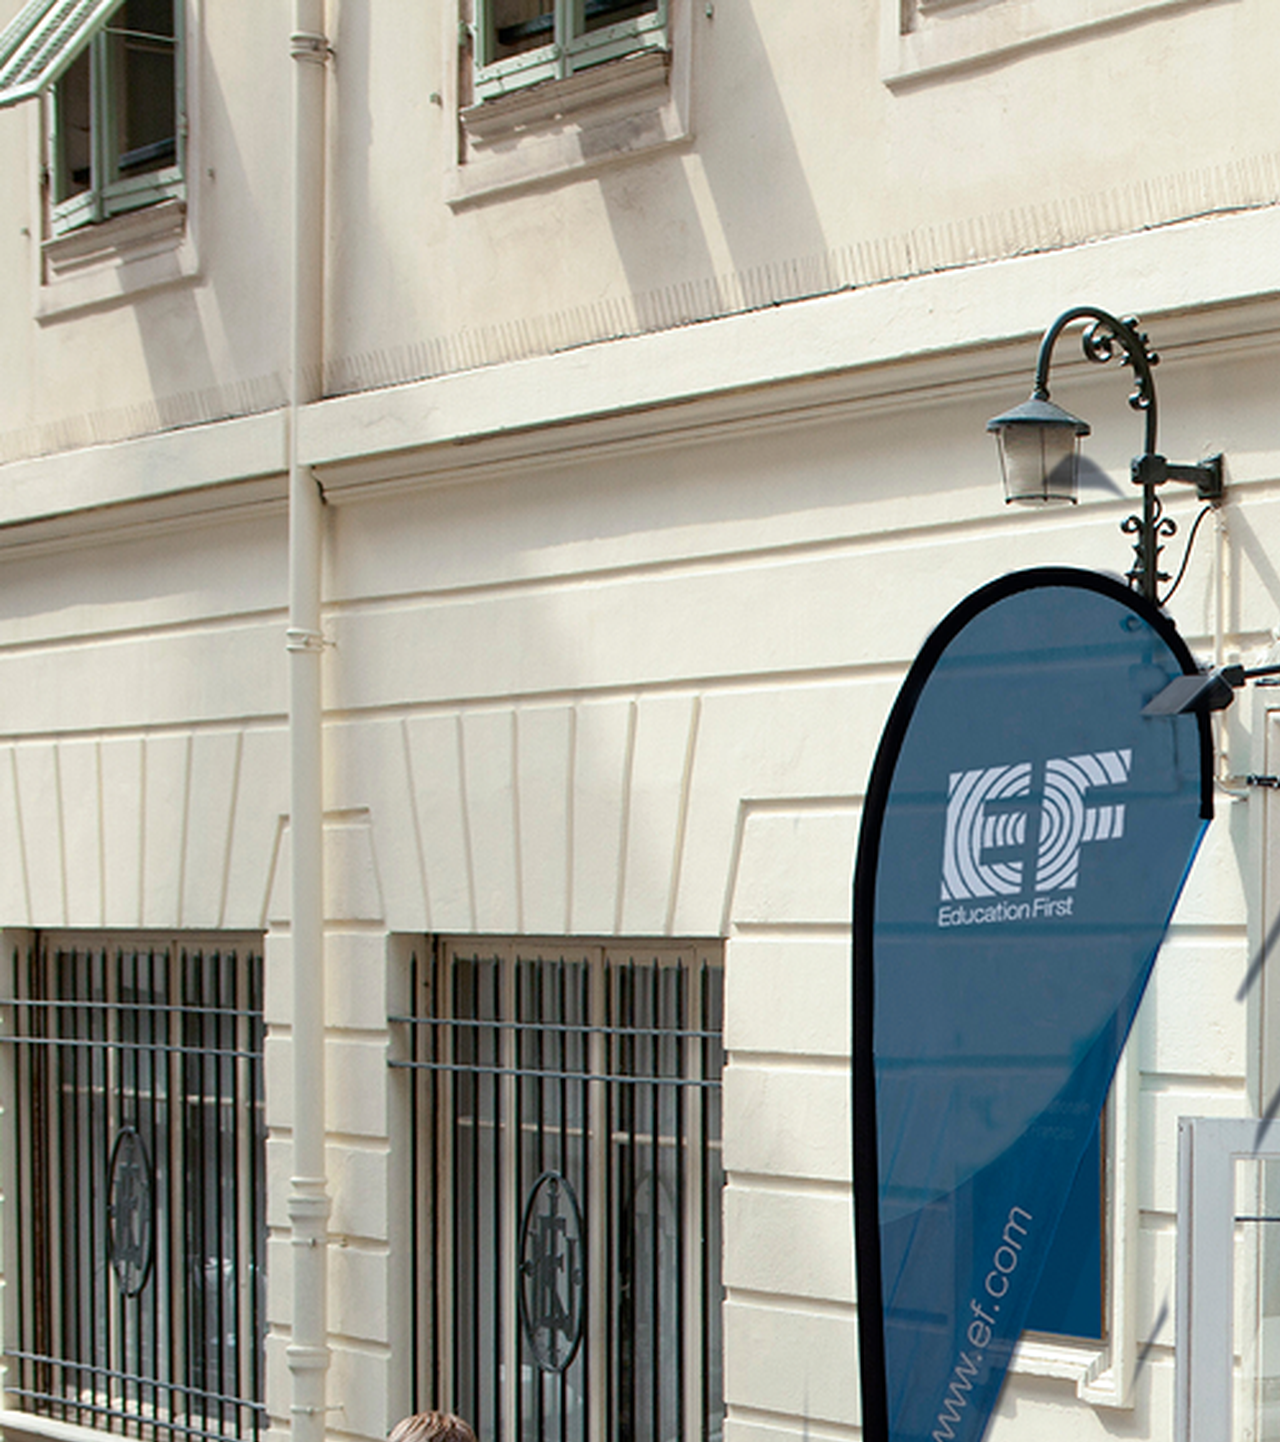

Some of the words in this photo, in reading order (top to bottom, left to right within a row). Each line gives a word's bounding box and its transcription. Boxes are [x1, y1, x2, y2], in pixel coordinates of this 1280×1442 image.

[941, 749, 1132, 900] EF
[938, 900, 1030, 927] Education
[1032, 896, 1074, 917] First
